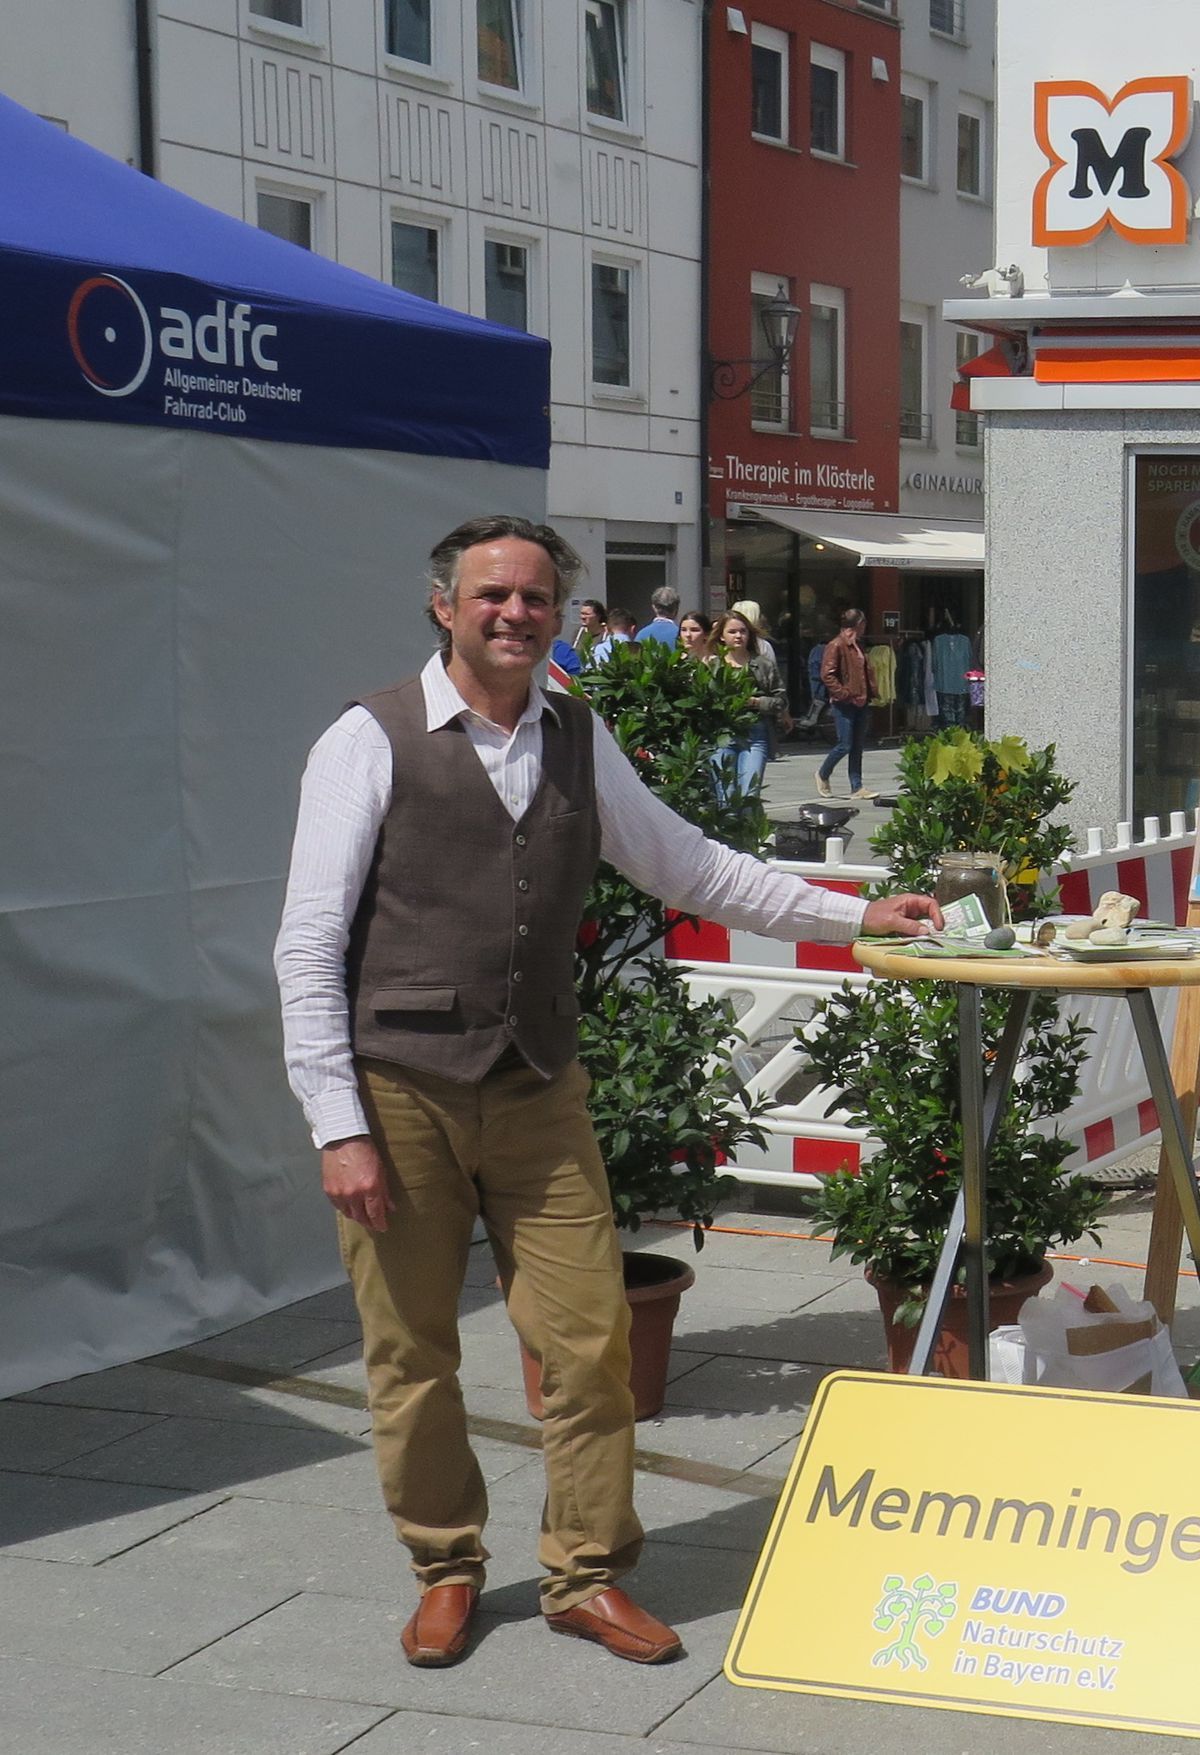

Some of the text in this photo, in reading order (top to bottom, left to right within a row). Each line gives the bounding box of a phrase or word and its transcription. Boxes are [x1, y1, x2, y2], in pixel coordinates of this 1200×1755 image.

[1070, 127, 1150, 199] M
[159, 299, 279, 372] adfc
[164, 367, 302, 403] Allgemeiner Deutscher
[164, 396, 247, 424] Fahrrad-Club
[726, 455, 790, 490] Therapie
[794, 462, 812, 485] im
[817, 464, 875, 491] Klösterle
[912, 473, 983, 496] GINALAUR
[1148, 465, 1188, 476] NOCH
[1148, 480, 1200, 492] SPAREN
[969, 1588, 1066, 1619] BUND
[962, 1620, 1125, 1659] Naturschutz
[953, 1650, 1117, 1691] in Bayern e.V.
